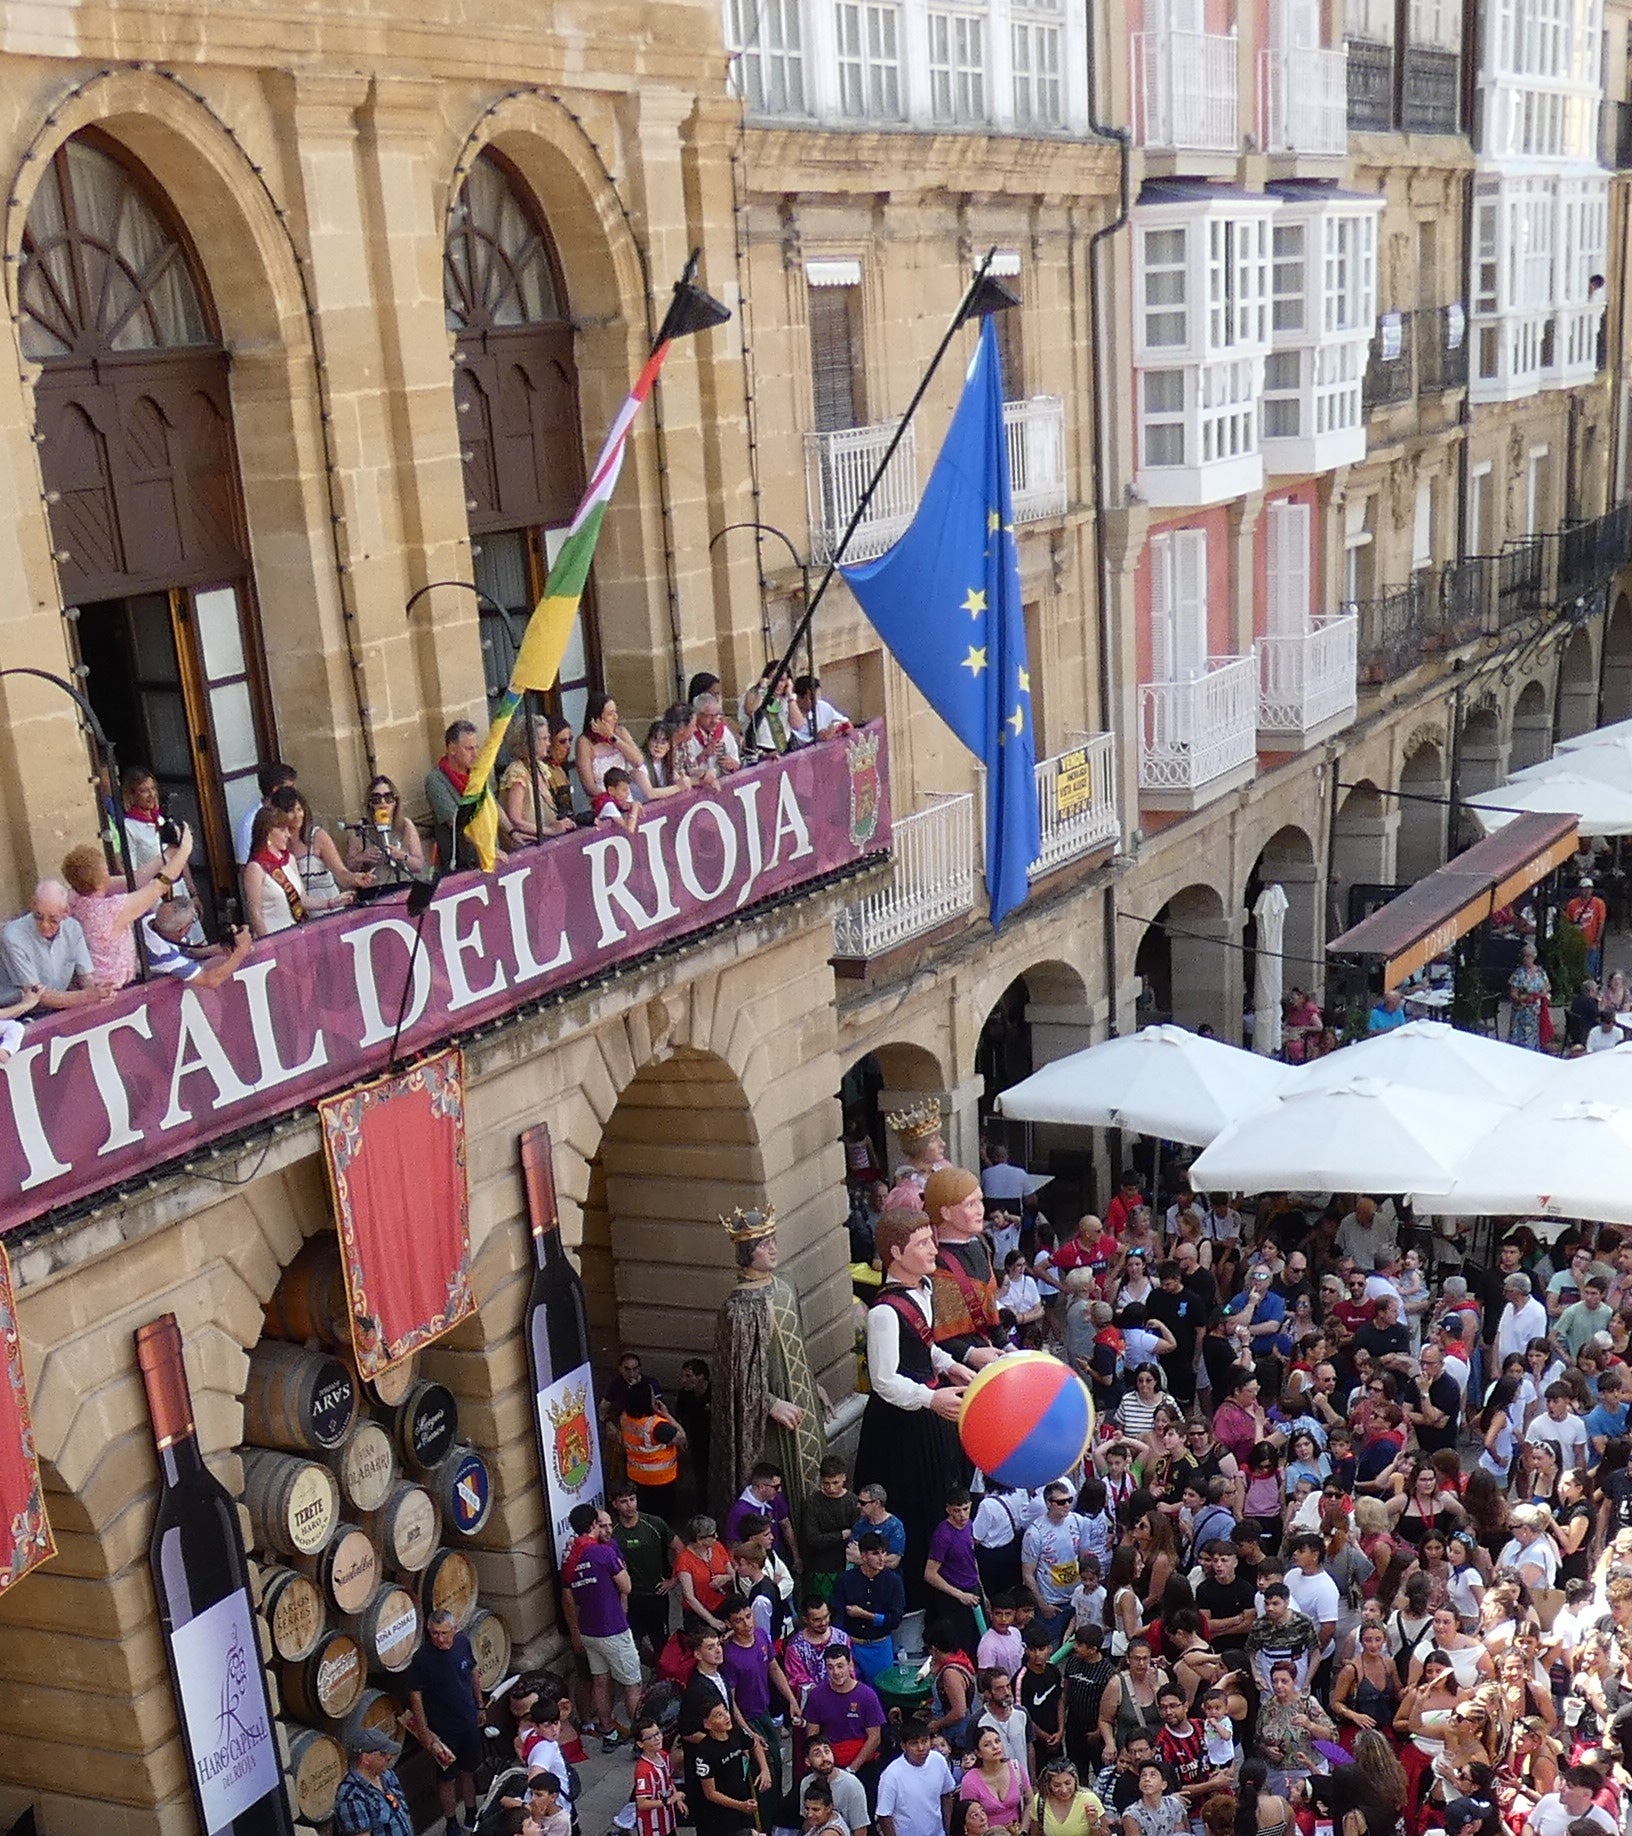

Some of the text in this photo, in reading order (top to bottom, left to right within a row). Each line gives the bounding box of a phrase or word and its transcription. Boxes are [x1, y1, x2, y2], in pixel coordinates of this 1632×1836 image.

[340, 867, 572, 1048] DEL
[581, 769, 814, 950] RIOJA
[294, 1498, 324, 1528] TERETE
[301, 1516, 323, 1536] HARO
[197, 1716, 268, 1786] HARO CAPITAL
[232, 1755, 257, 1788] RIOJA
